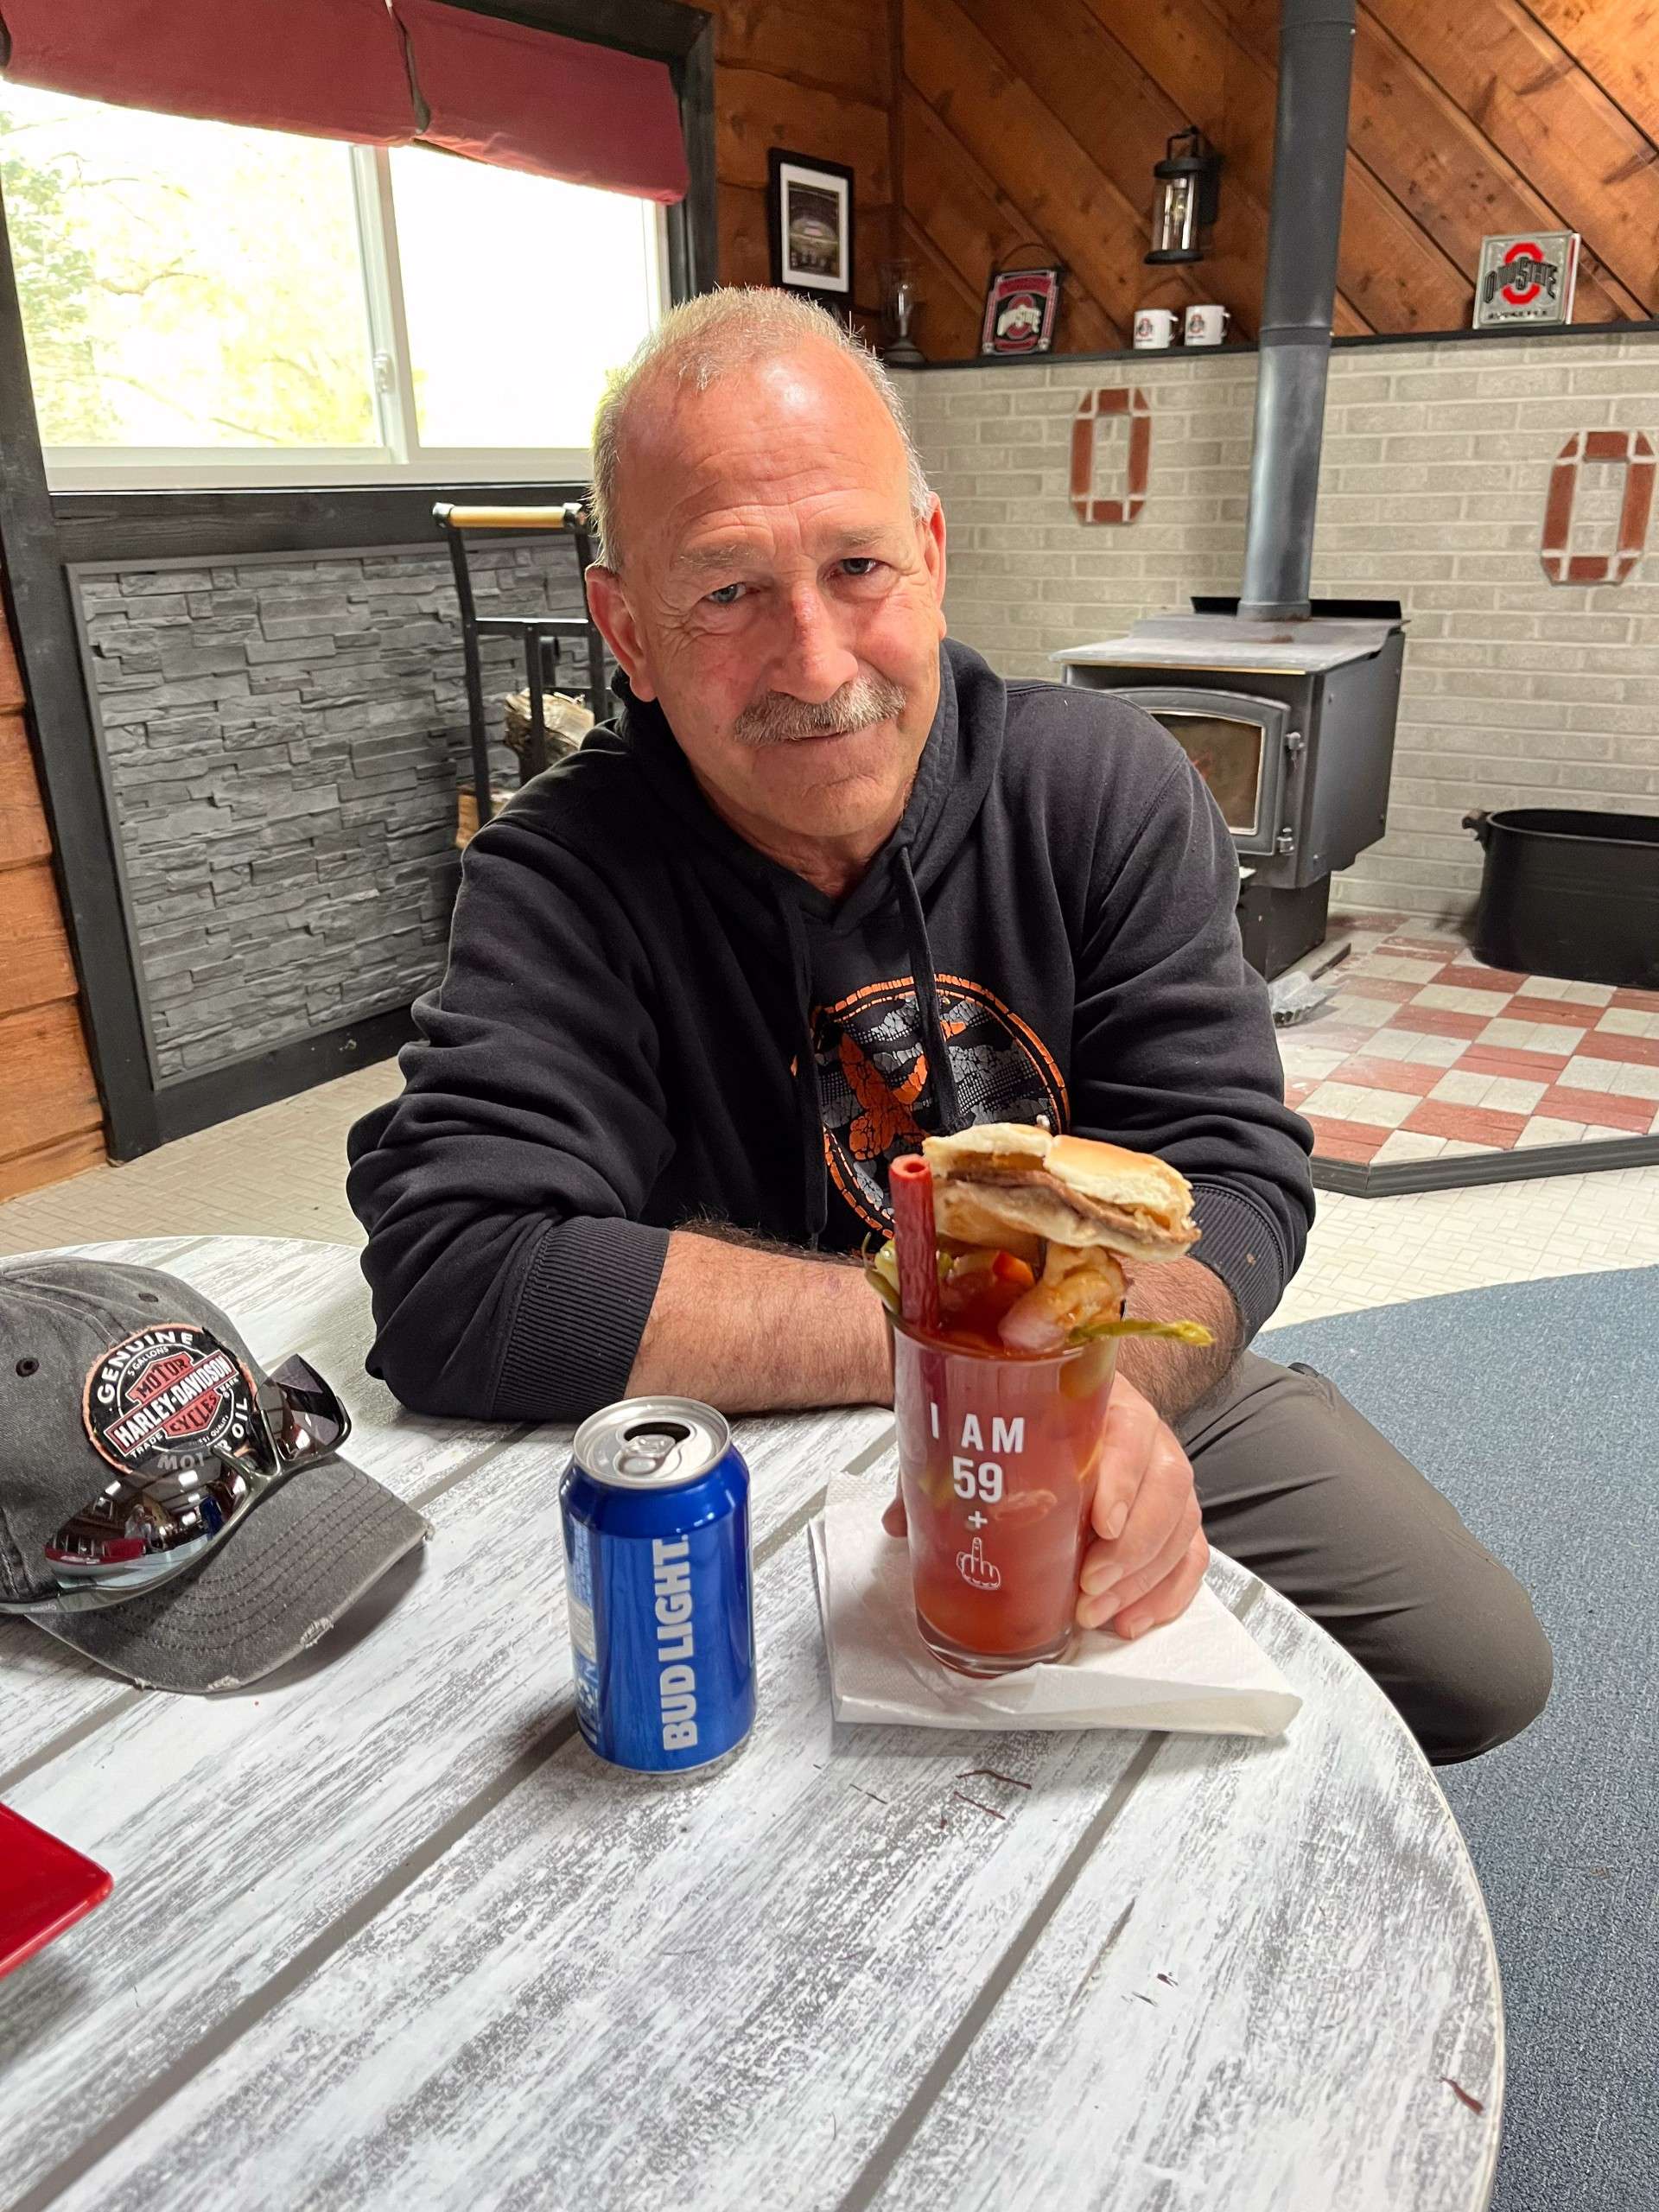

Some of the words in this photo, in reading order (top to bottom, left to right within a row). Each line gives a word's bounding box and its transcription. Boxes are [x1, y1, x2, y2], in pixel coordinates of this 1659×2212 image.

[97, 1331, 194, 1404] GENUINE
[131, 1346, 169, 1370] GALLONS
[136, 1358, 188, 1398] MOTOR
[113, 1357, 232, 1448] HARLEY-DAVIDSON
[169, 1392, 217, 1433] CYCLES
[231, 1397, 250, 1439] OIL
[130, 1432, 164, 1459] TRADE
[930, 1402, 940, 1440] I
[961, 1413, 1025, 1454] AM
[952, 1455, 1003, 1504] 59
[660, 1664, 698, 1751] BUD
